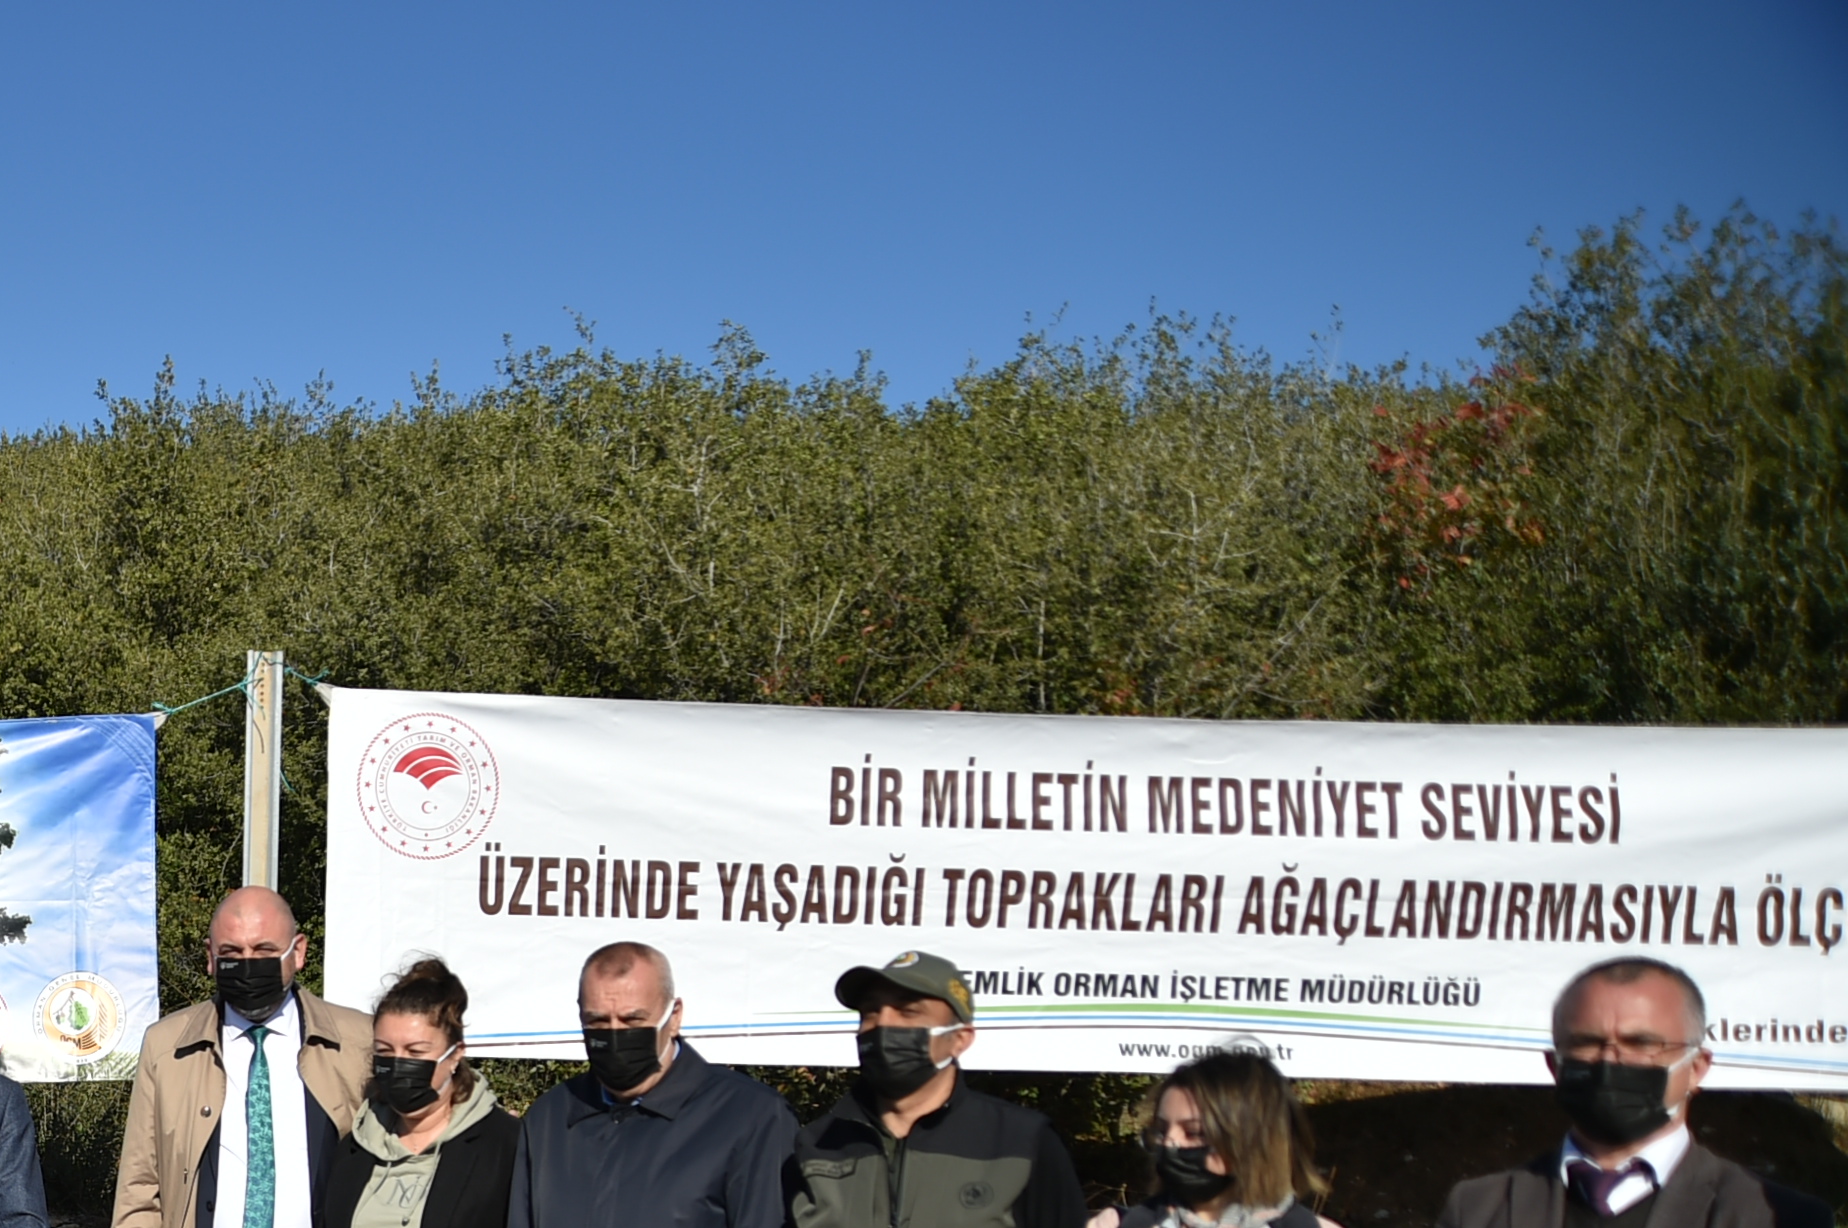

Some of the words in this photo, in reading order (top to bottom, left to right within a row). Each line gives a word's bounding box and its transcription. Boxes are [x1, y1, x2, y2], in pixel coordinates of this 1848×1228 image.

[829, 754, 903, 827] BİR
[922, 756, 1128, 832] MİLLETİN
[1147, 766, 1403, 839] MEDENİYET
[1420, 772, 1621, 845] SEVİYESİ
[479, 842, 700, 921] ÜZERİNDE
[717, 853, 926, 931] YAŞADIĞI
[943, 869, 1224, 936] TOPRAKLARI
[1238, 862, 1739, 947] AĞAÇLANDIRMASIYLA
[956, 966, 1045, 996] EMLİK
[1053, 973, 1160, 999] ORMAN
[1170, 970, 1290, 1003] İŞLETME
[1299, 974, 1481, 1007] MÜDÜRLÜĞÜ
